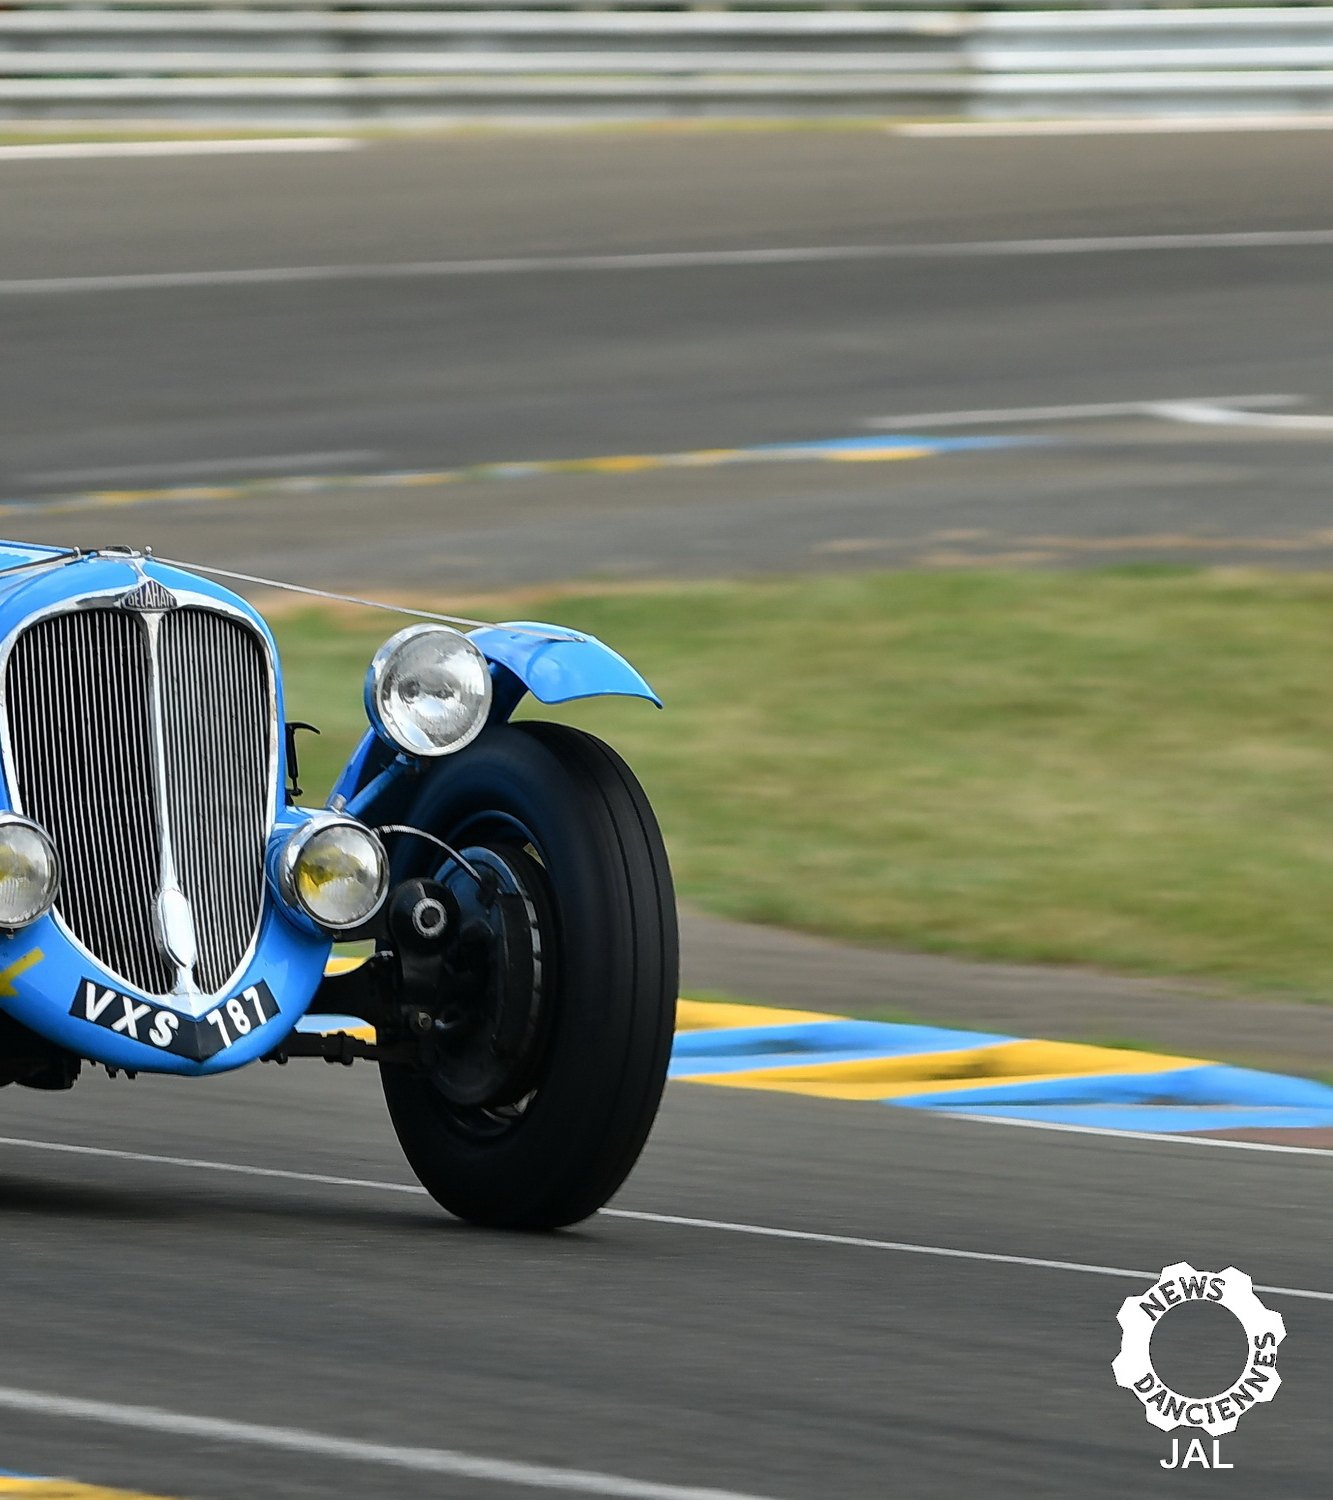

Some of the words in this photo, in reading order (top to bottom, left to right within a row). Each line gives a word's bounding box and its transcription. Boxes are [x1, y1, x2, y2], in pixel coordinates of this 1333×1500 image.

[128, 580, 175, 608] DELAHAYE
[85, 981, 180, 1048] VXS
[205, 985, 268, 1049] 787
